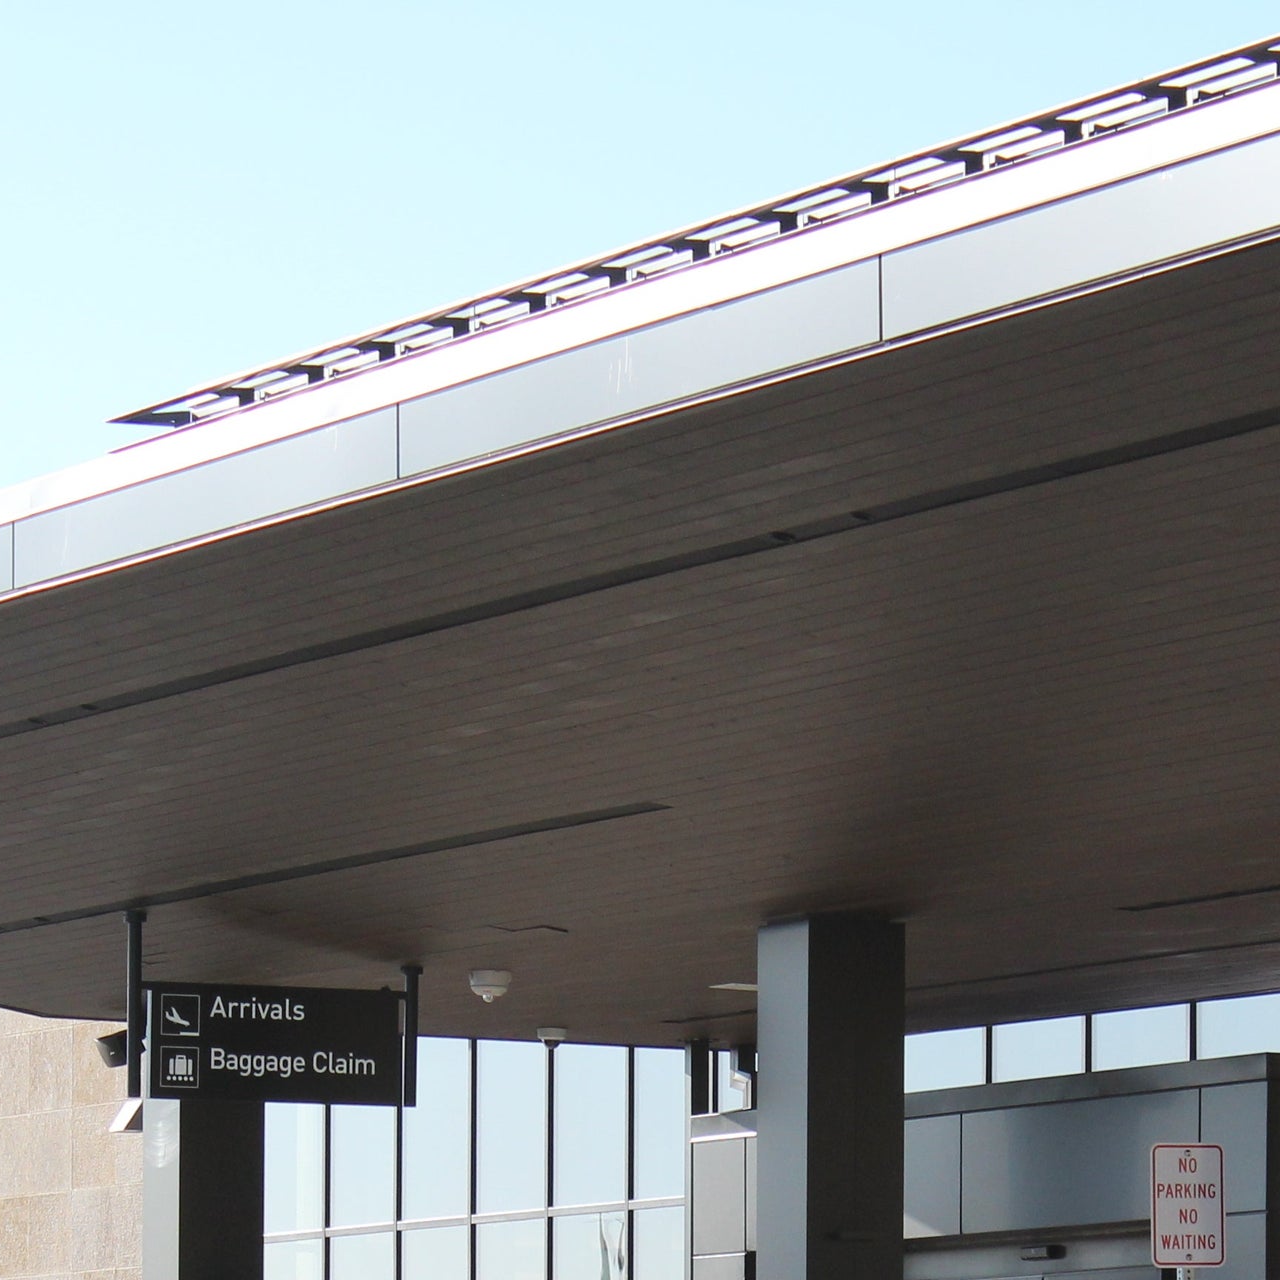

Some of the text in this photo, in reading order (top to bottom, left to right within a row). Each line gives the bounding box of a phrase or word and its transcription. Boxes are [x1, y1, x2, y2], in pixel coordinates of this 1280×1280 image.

[209, 995, 305, 1021] Arrivals
[209, 1047, 376, 1078] Baggage Claim
[1178, 1157, 1198, 1174] NO
[1156, 1183, 1216, 1199] PARKING
[1179, 1208, 1198, 1224] NO
[1161, 1234, 1216, 1250] WAITING
